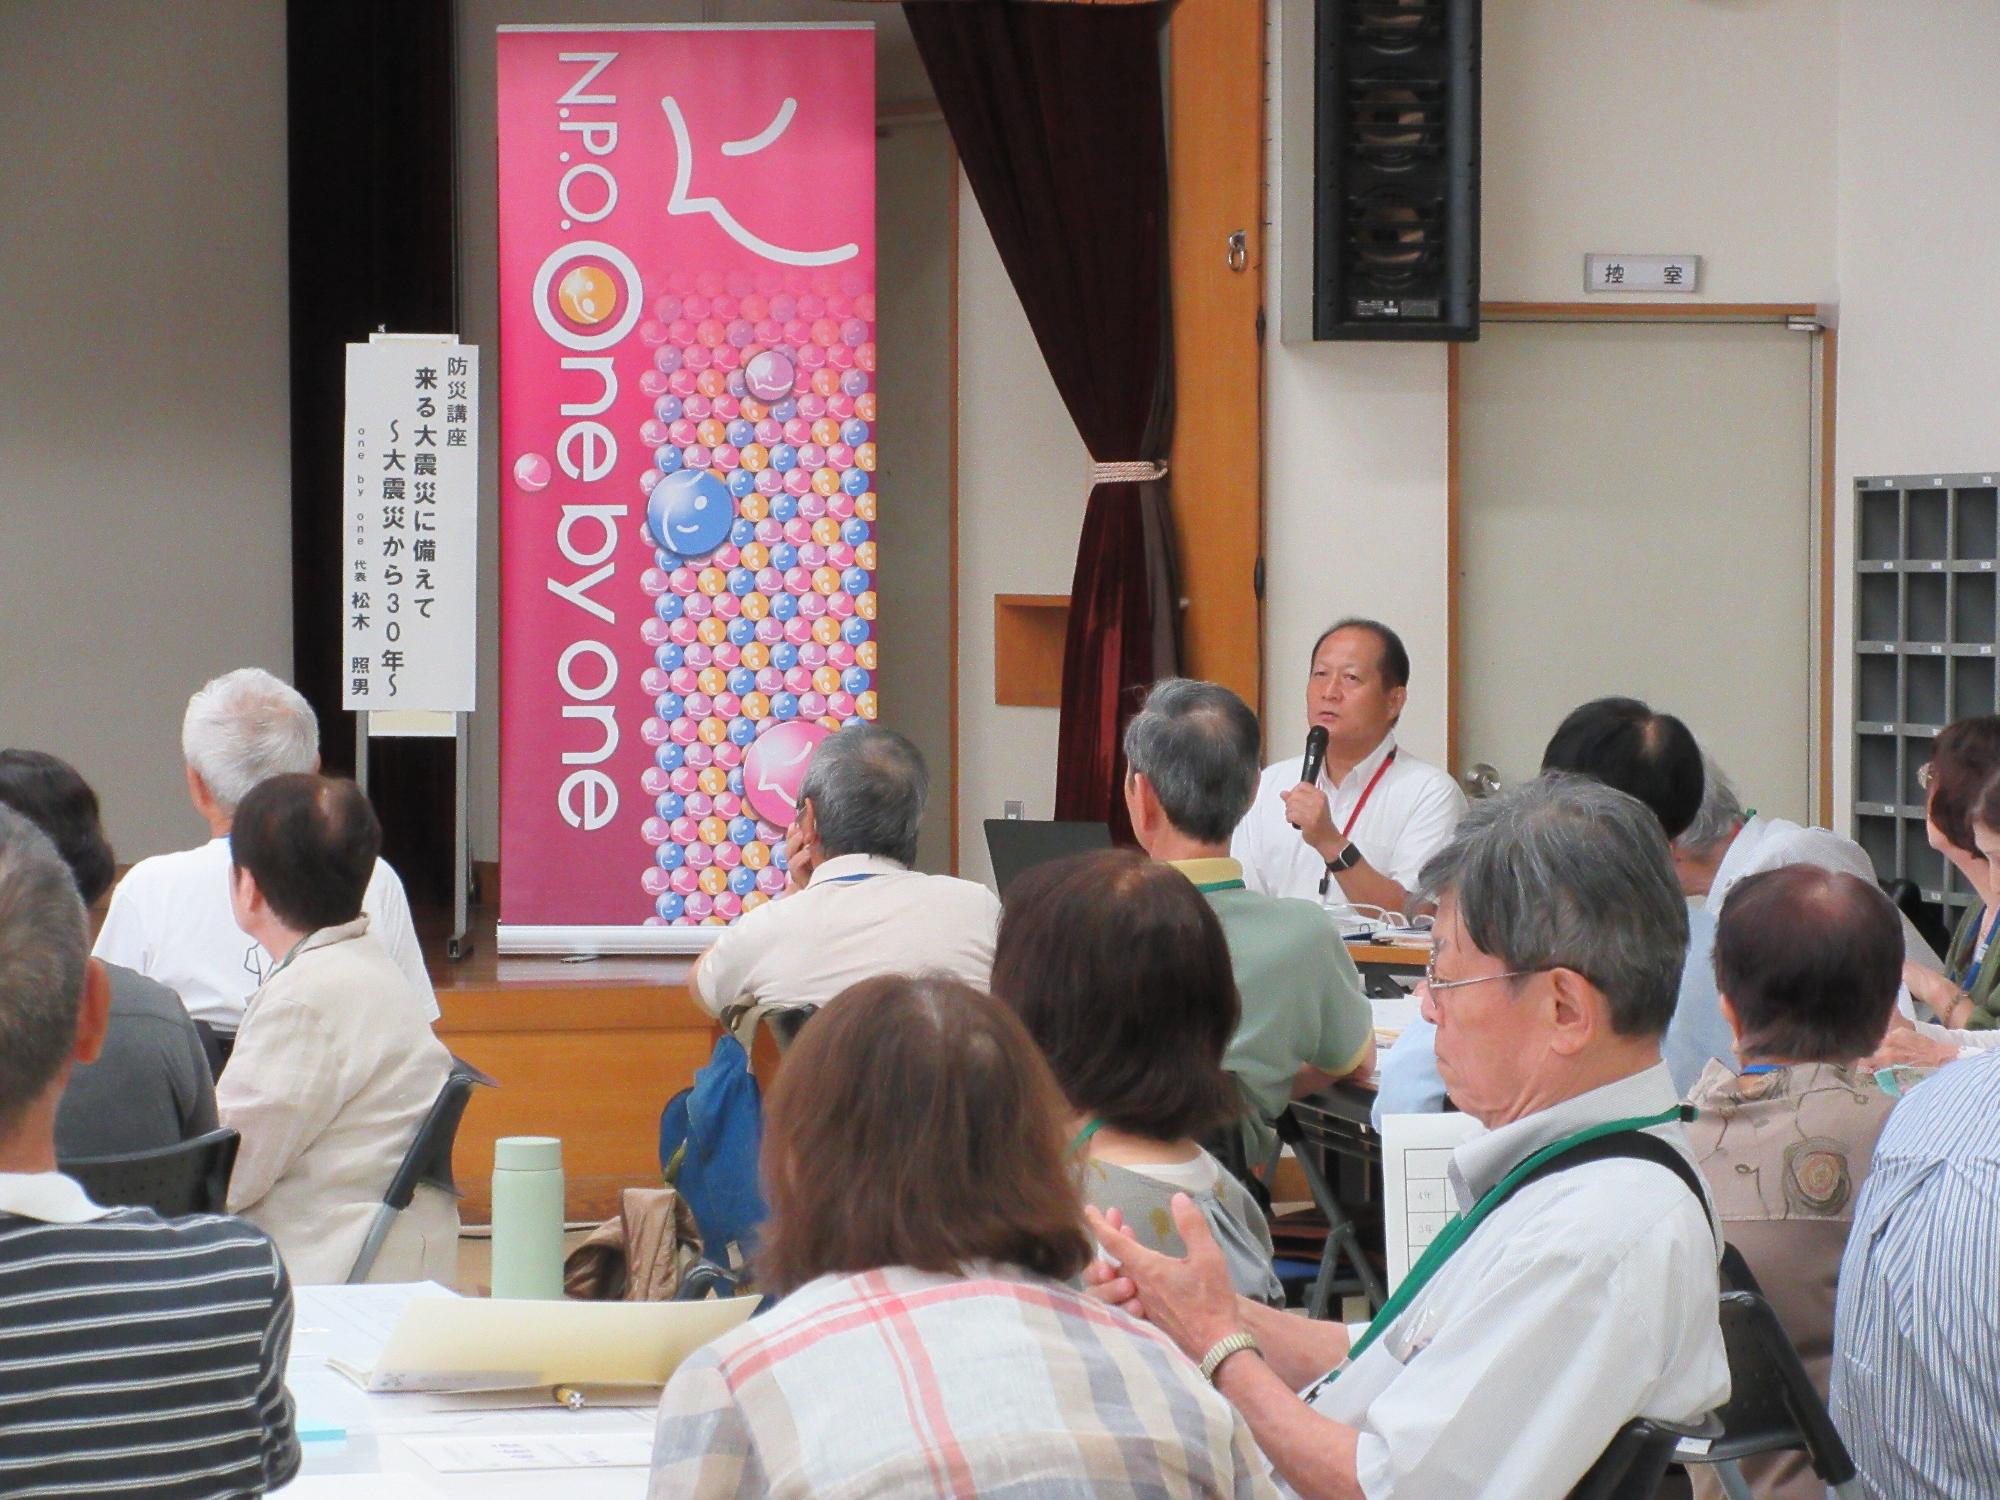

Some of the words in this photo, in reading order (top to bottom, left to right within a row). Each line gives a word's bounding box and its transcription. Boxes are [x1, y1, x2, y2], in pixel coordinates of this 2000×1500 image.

[556, 52, 619, 230] N.P.O.
[447, 356, 468, 447] 防災講座
[532, 240, 643, 482] One
[357, 427, 365, 460] one
[357, 475, 365, 496] by
[356, 513, 364, 546] one
[413, 366, 438, 619] 来る大震災に備えて
[354, 559, 367, 583] 代表
[547, 504, 628, 625] by
[352, 657, 370, 696] 照男
[557, 639, 619, 831] one
